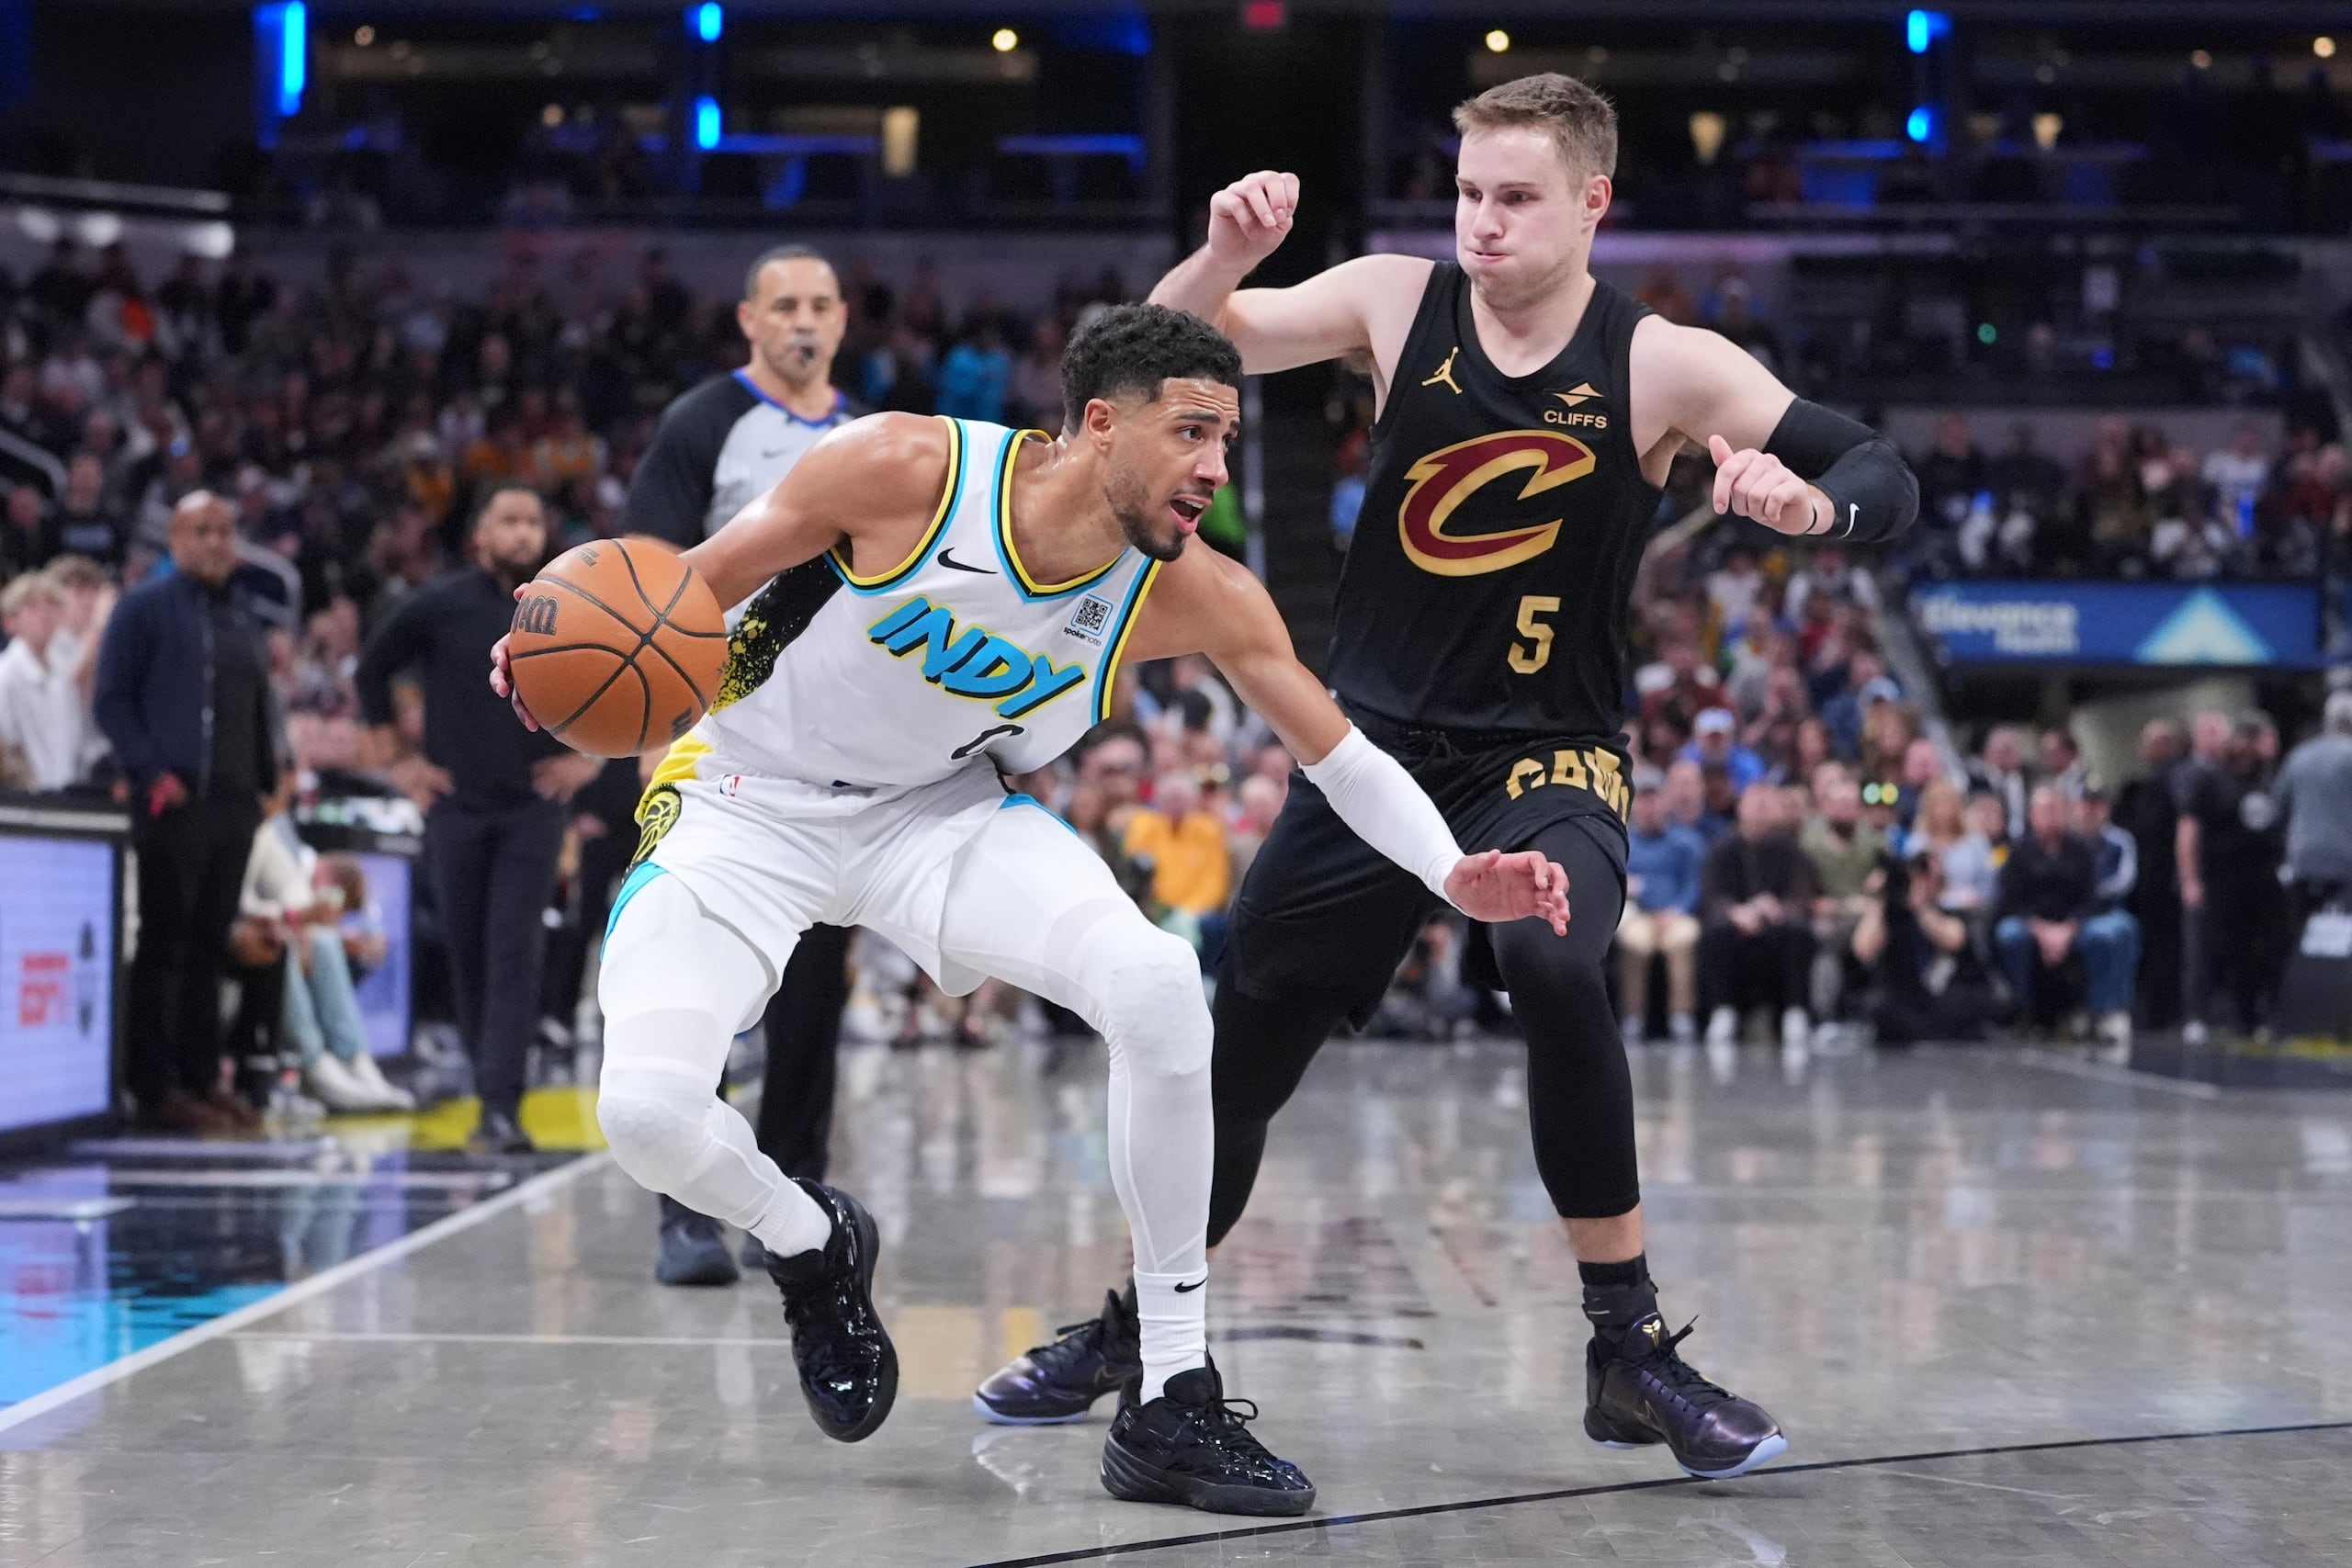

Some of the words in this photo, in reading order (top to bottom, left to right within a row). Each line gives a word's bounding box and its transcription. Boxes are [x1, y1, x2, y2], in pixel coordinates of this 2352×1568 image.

[1544, 410, 1607, 429] CLIFFS
[1398, 429, 1597, 577] C
[866, 594, 1089, 720] INDY
[1063, 626, 1102, 646] spokenote
[1508, 595, 1561, 674] 5
